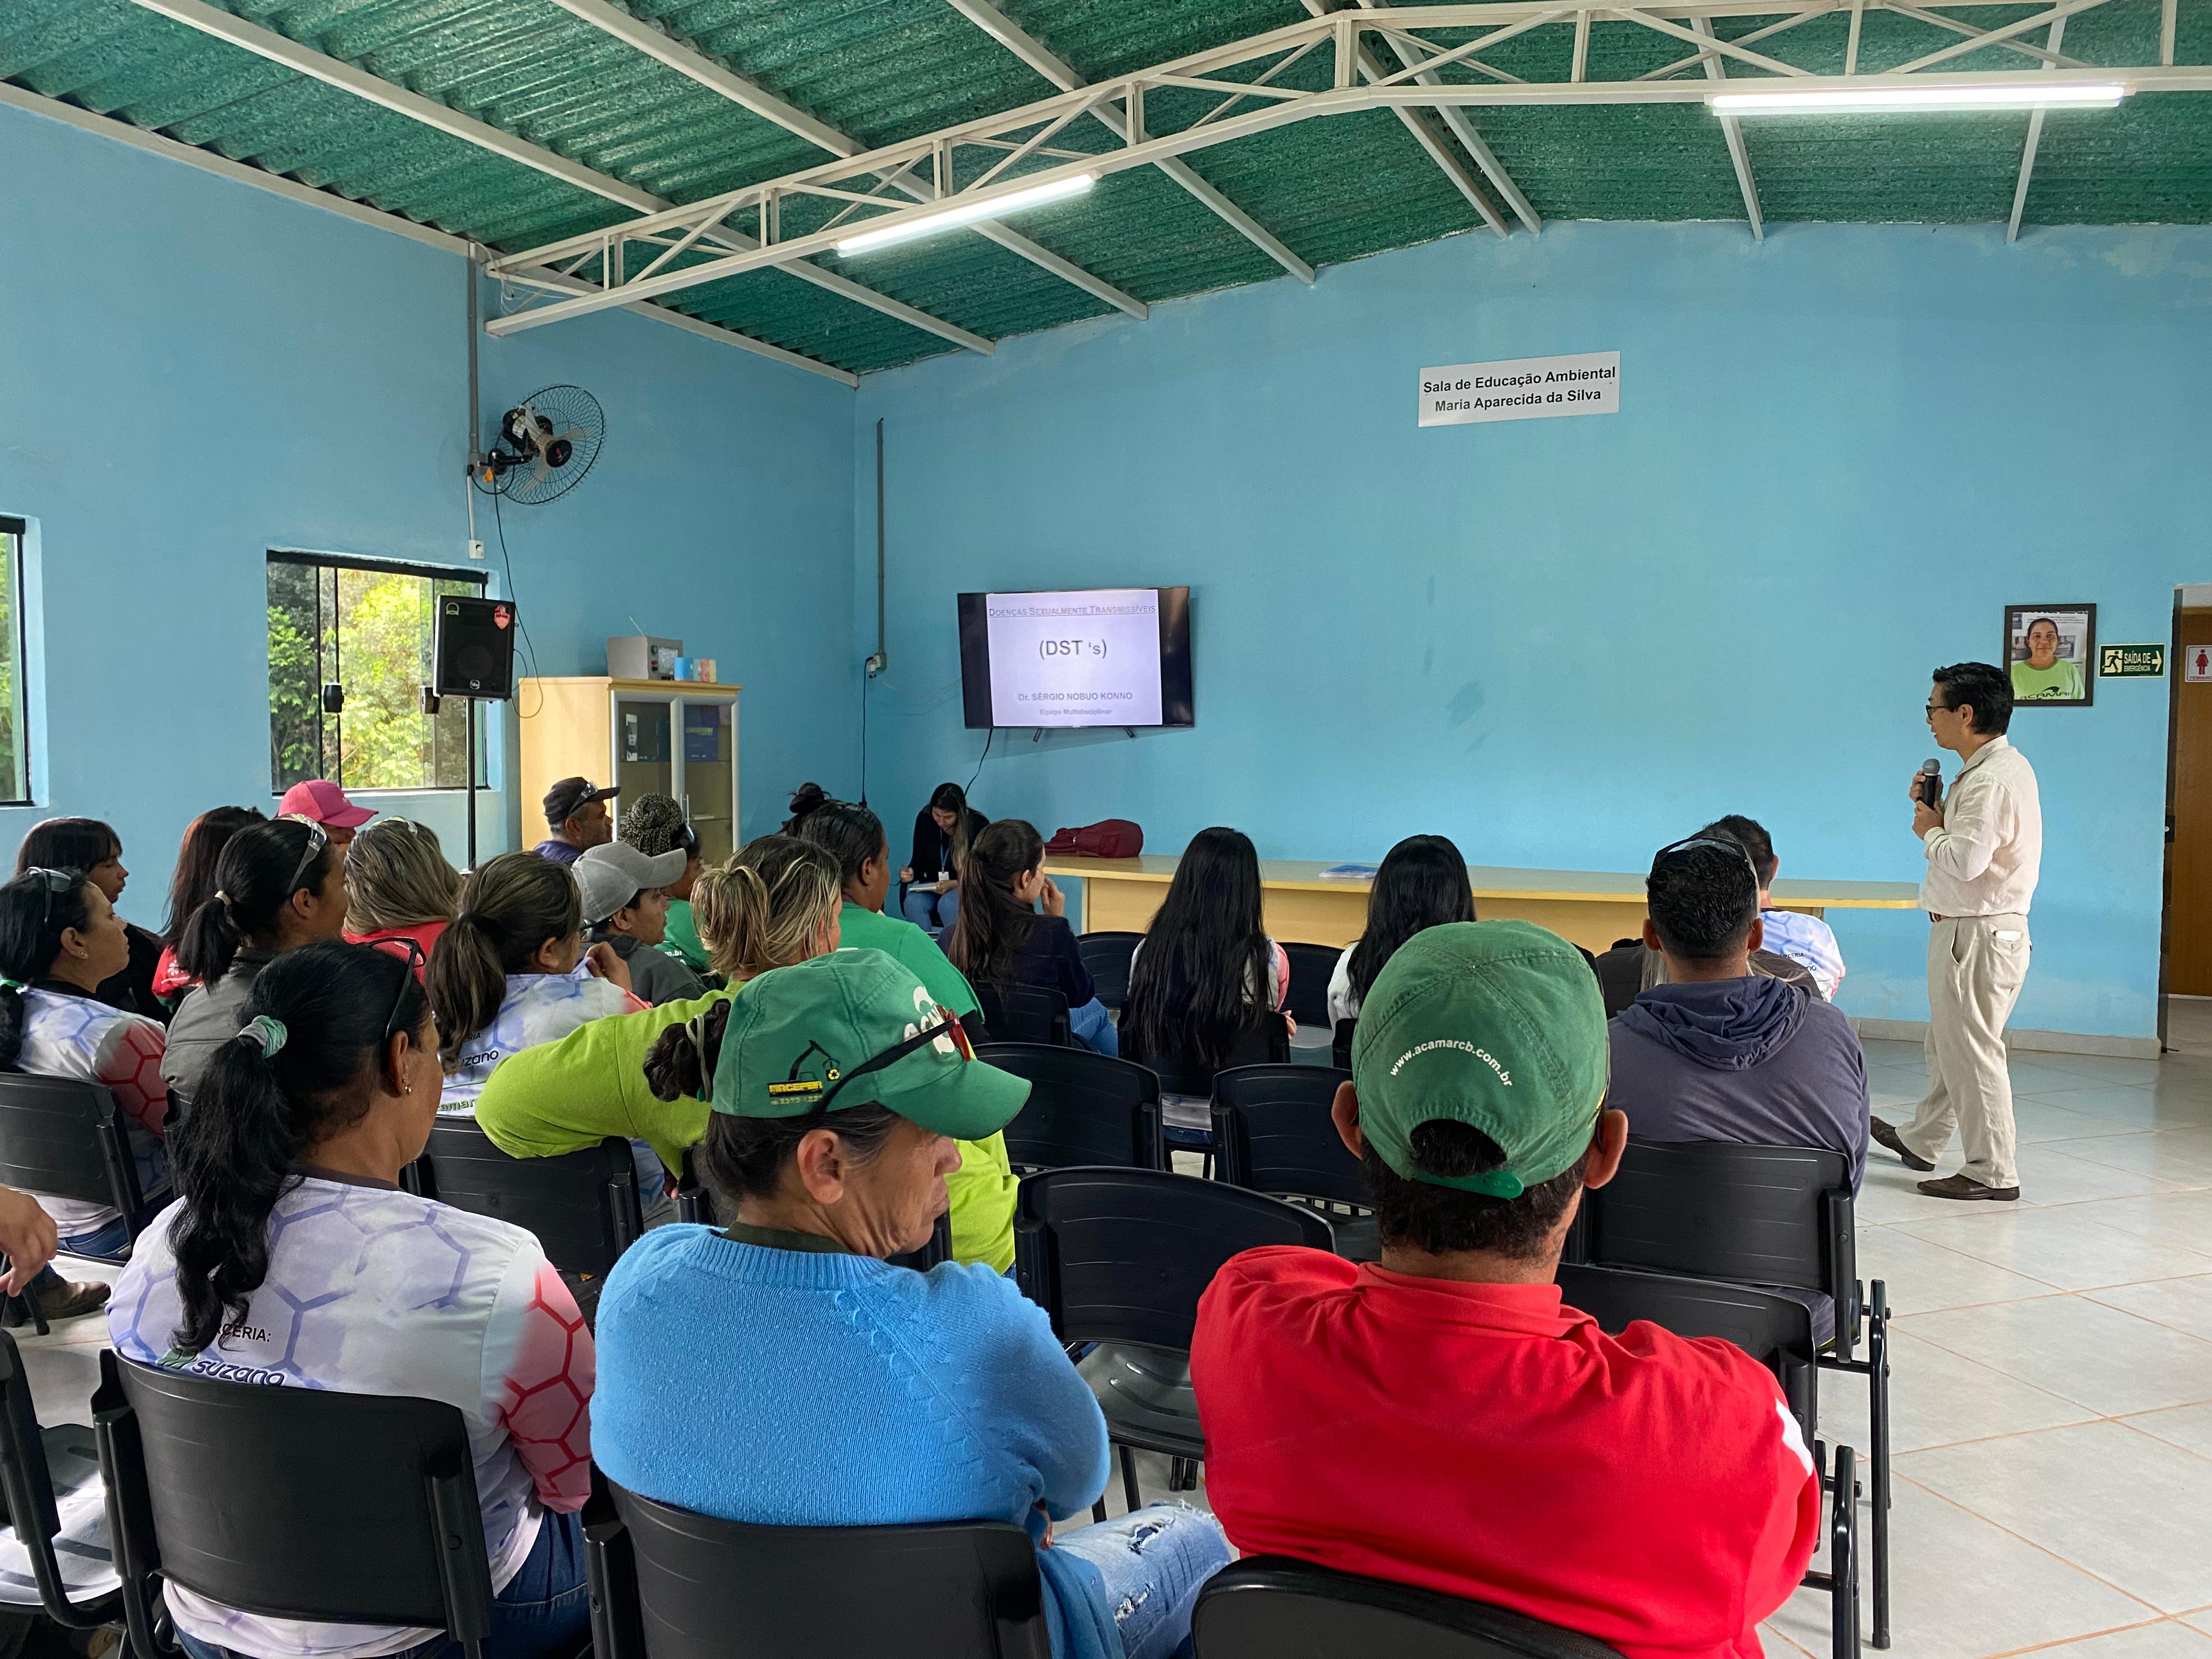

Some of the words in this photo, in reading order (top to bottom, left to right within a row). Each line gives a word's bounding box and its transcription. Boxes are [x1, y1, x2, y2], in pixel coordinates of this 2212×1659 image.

[1424, 381, 1451, 393] Sala
[1455, 379, 1471, 390] de
[1476, 374, 1542, 388] Educação
[1545, 366, 1616, 383] Ambiental
[1435, 399, 1470, 412] Maria
[1474, 393, 1542, 410] Aparecida
[1547, 391, 1562, 403] da
[1567, 390, 1601, 402] Silva
[1040, 640, 1083, 659] (DST
[2124, 651, 2142, 664] SAÍDA
[2143, 652, 2151, 664] DE
[1032, 692, 1065, 701] SÉRGIO
[1390, 1040, 1513, 1087] www.acamarcb.com.br
[193, 1361, 284, 1386] suzano
